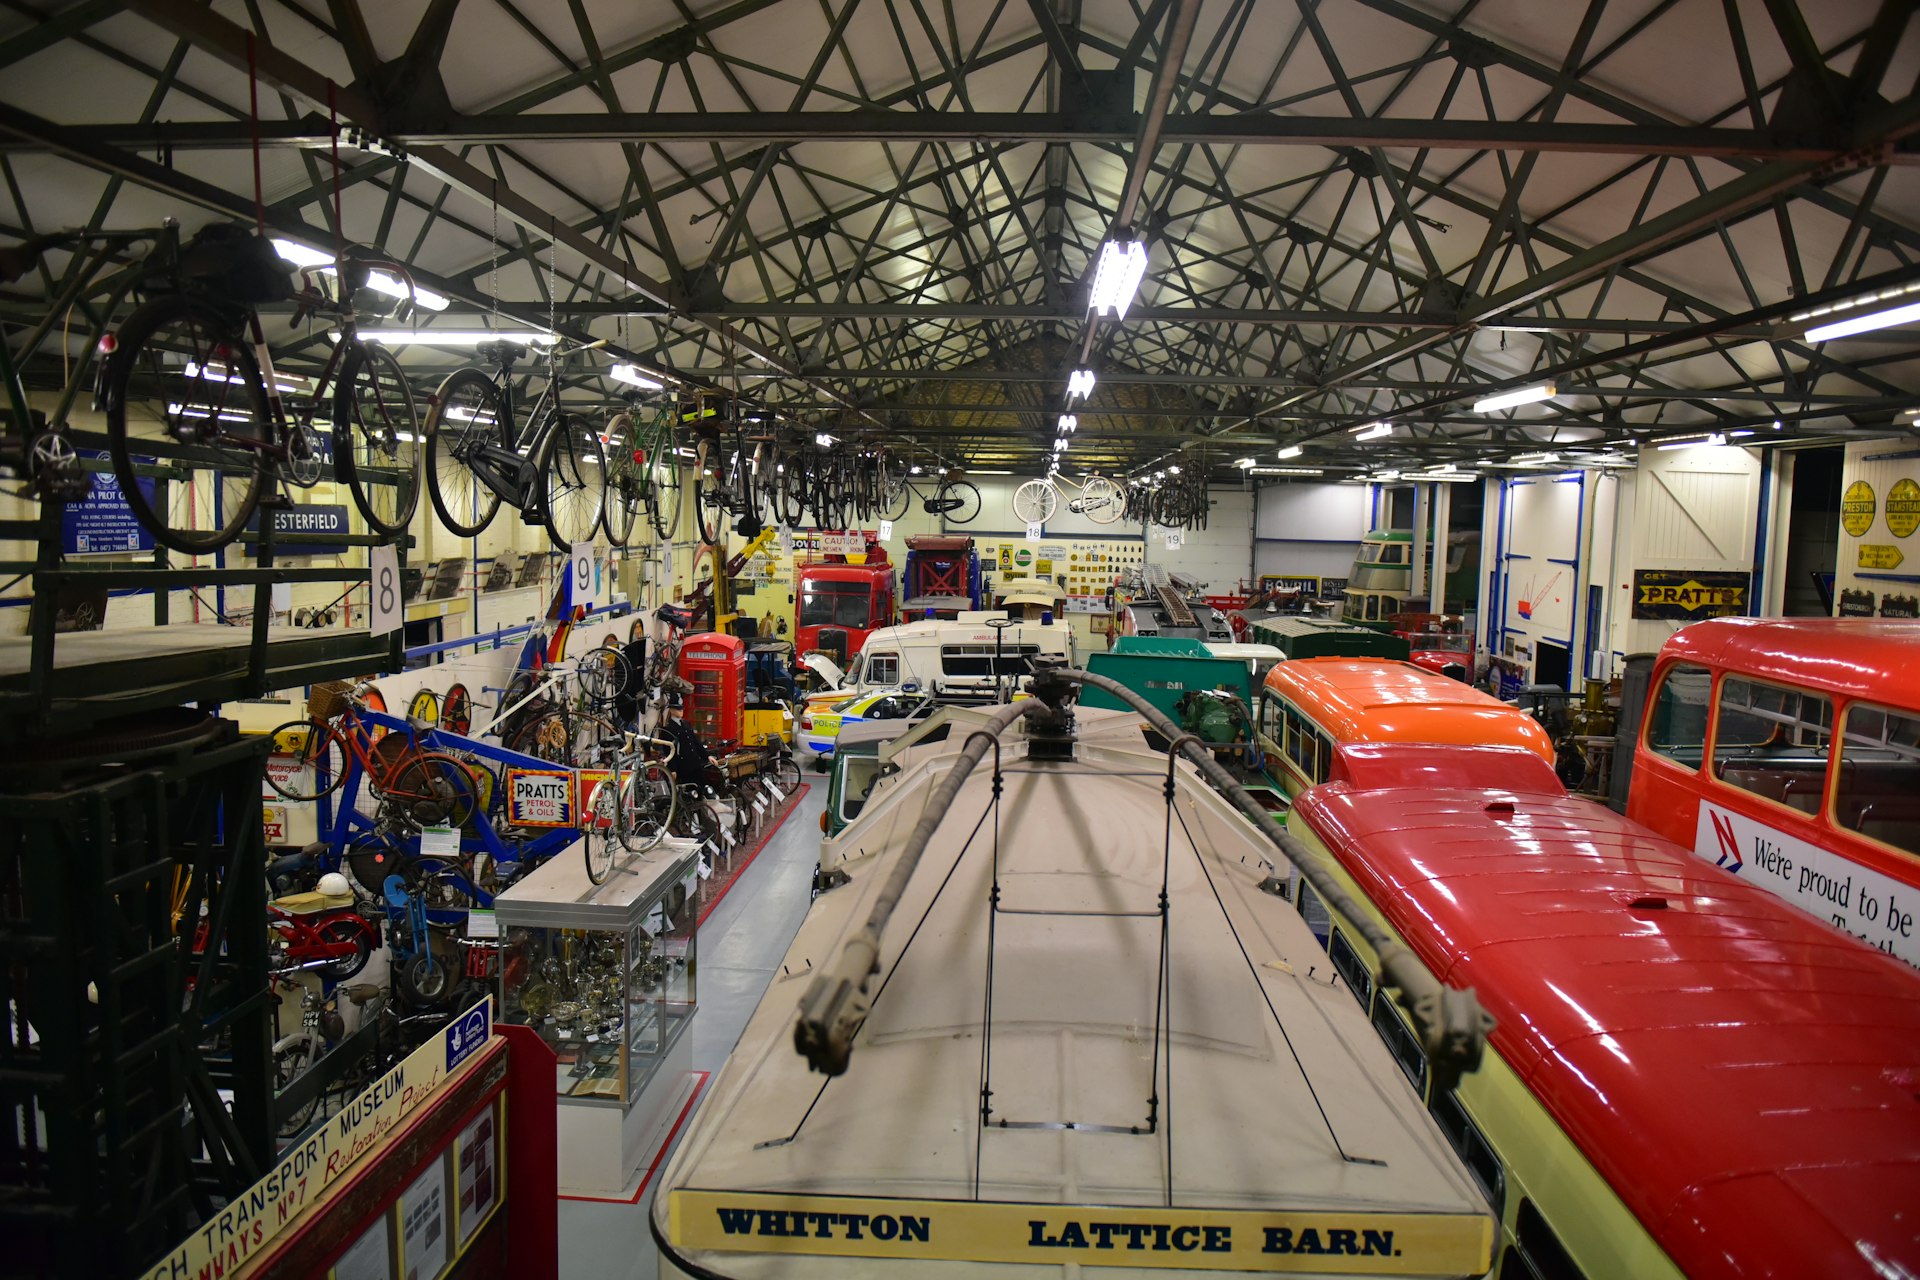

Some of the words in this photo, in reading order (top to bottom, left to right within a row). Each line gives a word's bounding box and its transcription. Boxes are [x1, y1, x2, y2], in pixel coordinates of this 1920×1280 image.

[98, 491, 115, 500] PILOT
[1844, 502, 1874, 512] PRESTON
[274, 514, 338, 530] ESTERFIELD
[882, 526, 891, 535] 17
[1028, 528, 1040, 537] 18
[824, 537, 859, 545] CAUTON
[1167, 535, 1179, 544] 19
[664, 552, 672, 574] 10
[578, 556, 590, 591] 9
[380, 566, 394, 614] 8
[1884, 608, 1912, 617] NATURAL
[814, 719, 843, 729] POLICE
[517, 783, 565, 799] PRATTS
[526, 799, 555, 807] PETROL
[537, 808, 555, 816] OILS
[1754, 836, 1792, 880] We're
[1798, 865, 1851, 908] proud
[1860, 886, 1878, 921] to
[1887, 896, 1913, 938] be
[303, 1019, 319, 1027] 584
[450, 1048, 468, 1067] LOTTERY
[468, 1035, 485, 1052] FUNDED
[324, 1113, 392, 1184] Restoration
[399, 1065, 438, 1117] Project
[202, 1128, 328, 1254] TRANSPORT
[340, 1066, 404, 1139] MUSEUM
[716, 1207, 930, 1243] WHITTON
[1028, 1220, 1231, 1253] LATTICE
[1261, 1226, 1402, 1257] BARN.
